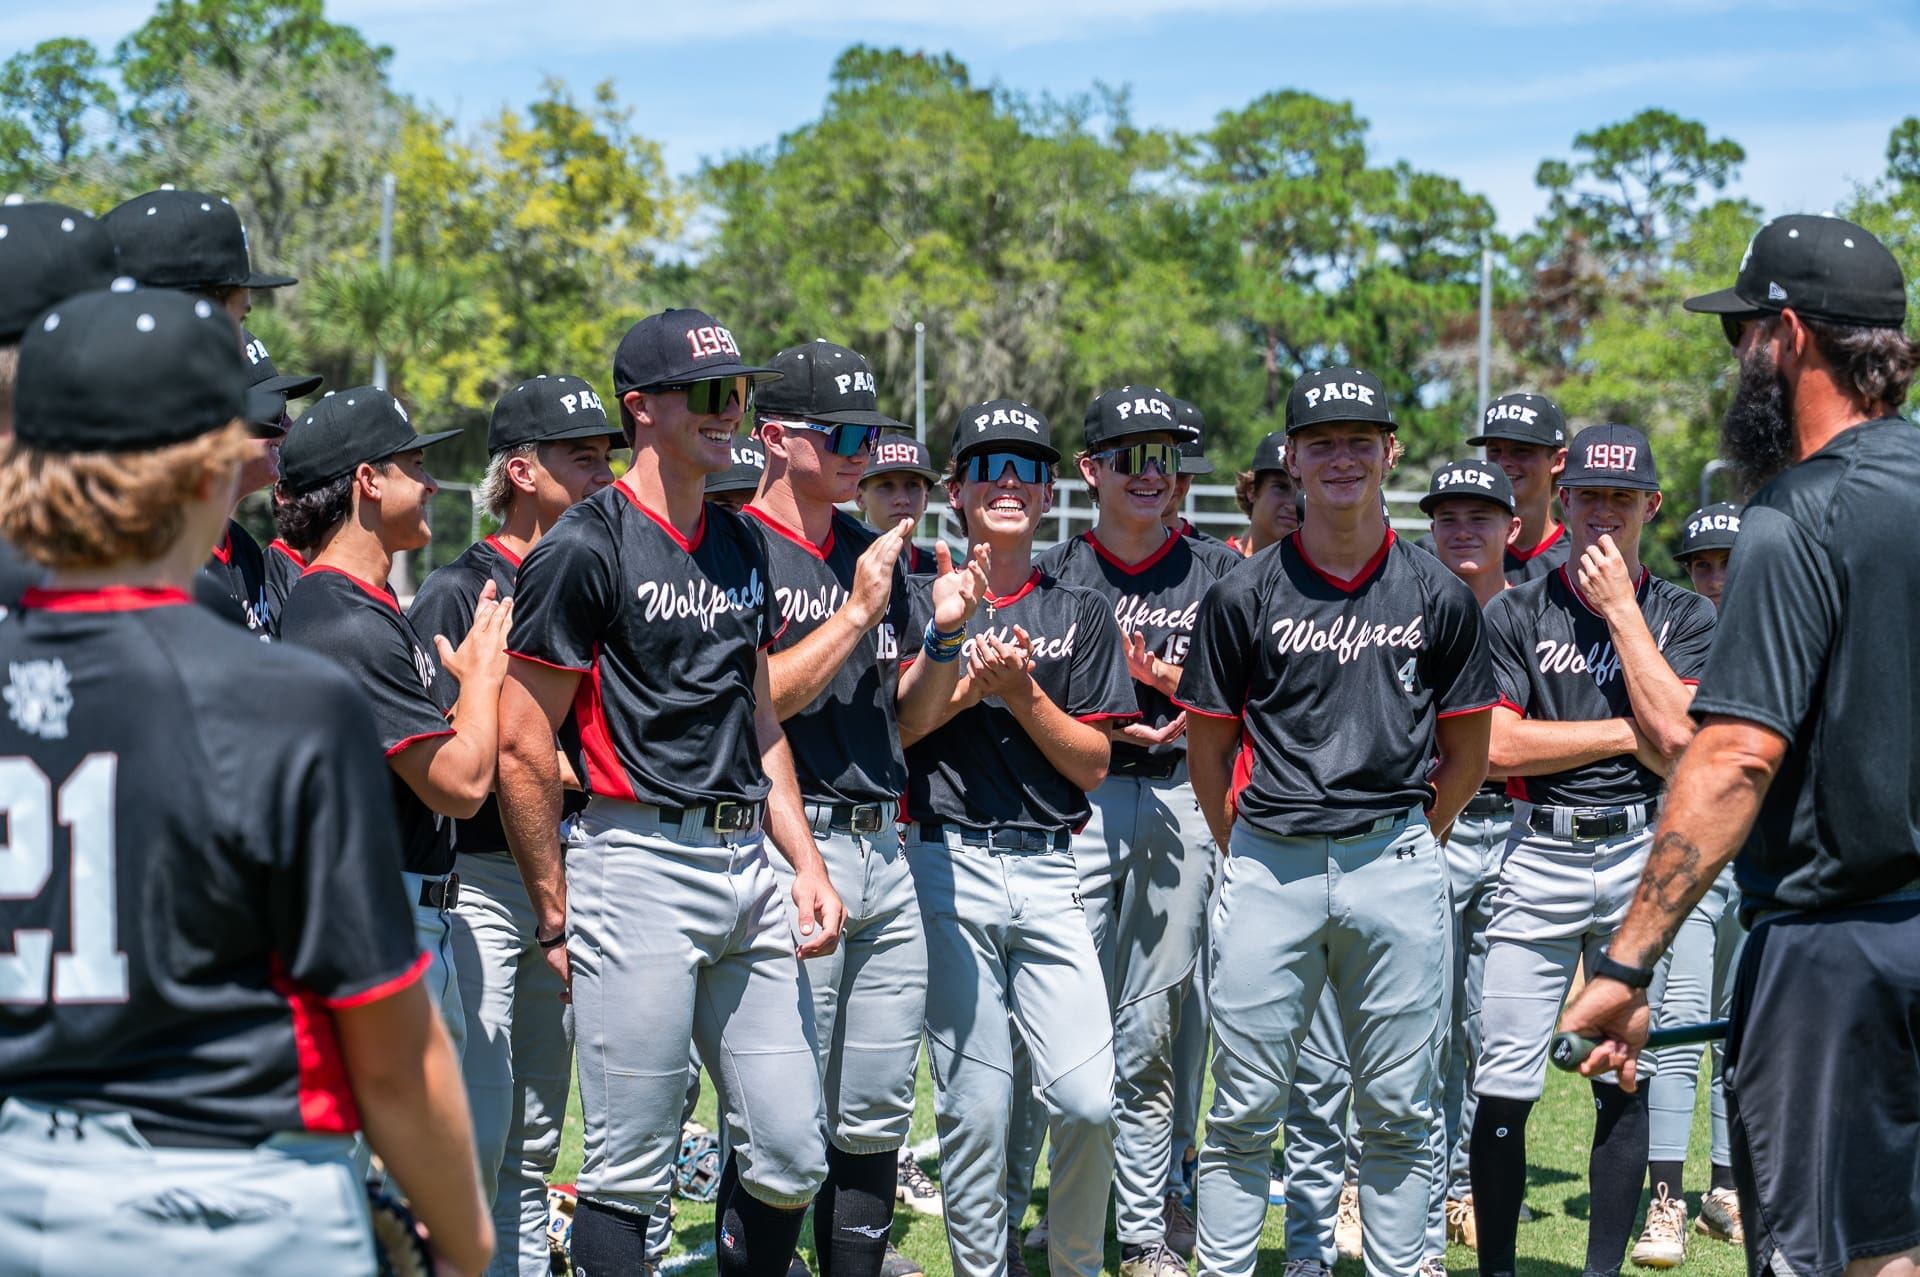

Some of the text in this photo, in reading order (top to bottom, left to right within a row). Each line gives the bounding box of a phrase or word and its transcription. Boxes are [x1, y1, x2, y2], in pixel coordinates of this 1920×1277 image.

[1304, 382, 1375, 408] PACK
[974, 409, 1040, 434] PACK
[1486, 404, 1538, 425] PACK
[731, 447, 765, 469] ACK
[876, 443, 919, 465] 1997
[1584, 444, 1637, 472] 1997
[1437, 469, 1495, 491] PACK
[1688, 514, 1741, 538] PACK
[638, 568, 764, 633] Wolfpack
[1114, 595, 1199, 634] lfpack
[876, 623, 898, 660] 16
[1162, 634, 1191, 665] 15
[1271, 615, 1422, 665] Wolfpack
[1397, 656, 1417, 692] 4
[0, 752, 129, 1003] 21
